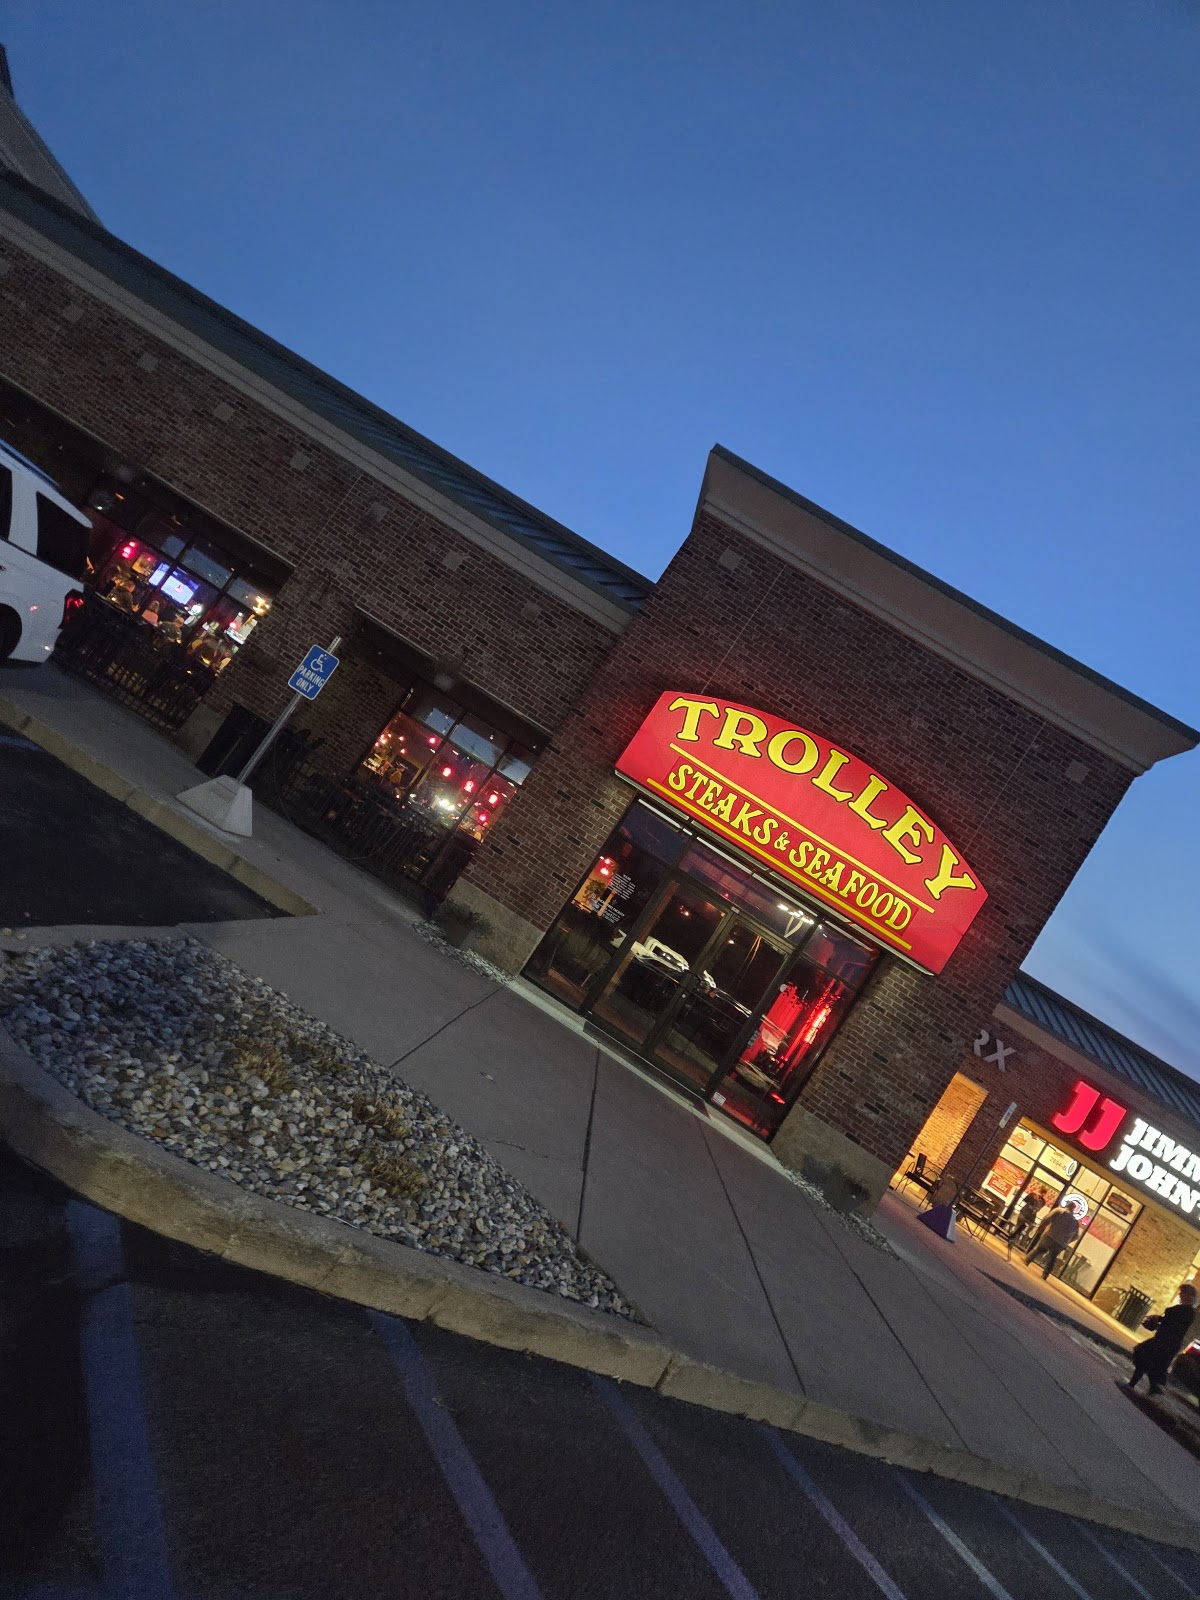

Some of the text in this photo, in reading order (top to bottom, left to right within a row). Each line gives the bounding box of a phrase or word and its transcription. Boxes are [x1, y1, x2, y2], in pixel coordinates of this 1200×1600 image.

[295, 677, 315, 693] ONLY
[297, 665, 325, 688] PARKING
[668, 697, 977, 900] TROLLEY
[668, 763, 912, 931] STEAKS & SEAFOOD
[1052, 1080, 1127, 1151] JJ
[1109, 1143, 1200, 1213] JOHN
